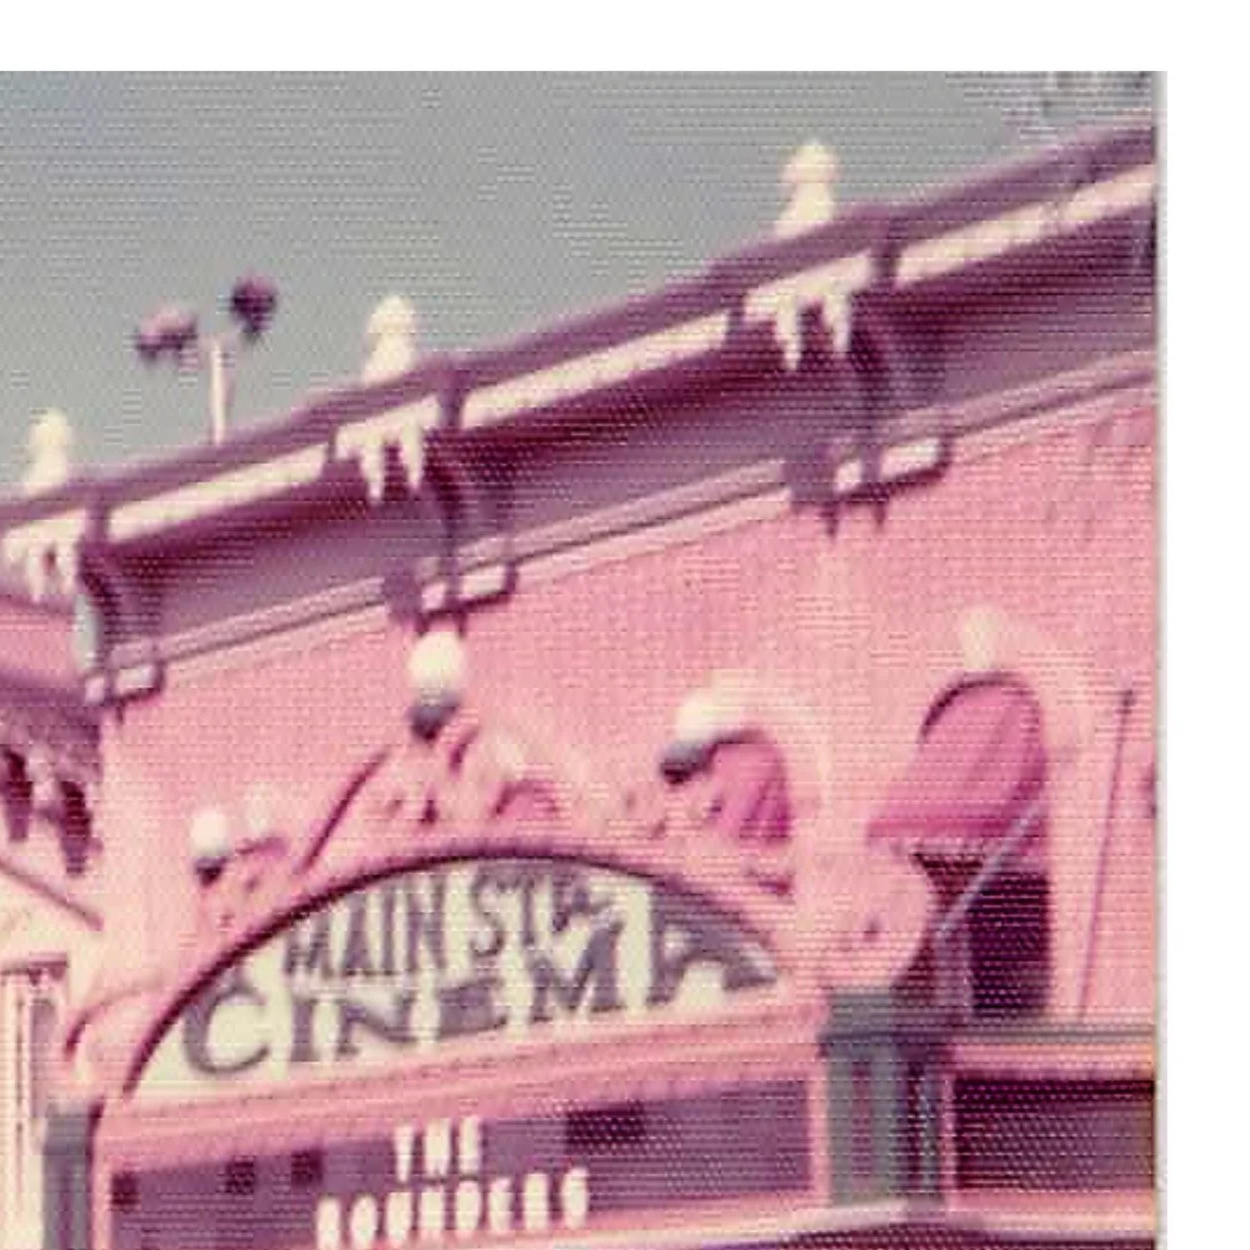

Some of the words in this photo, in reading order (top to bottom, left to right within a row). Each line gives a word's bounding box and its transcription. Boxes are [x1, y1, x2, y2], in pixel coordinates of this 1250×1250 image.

[182, 876, 778, 1077] CINEMA
[284, 871, 443, 980] MAIN
[393, 1114, 483, 1184] THE
